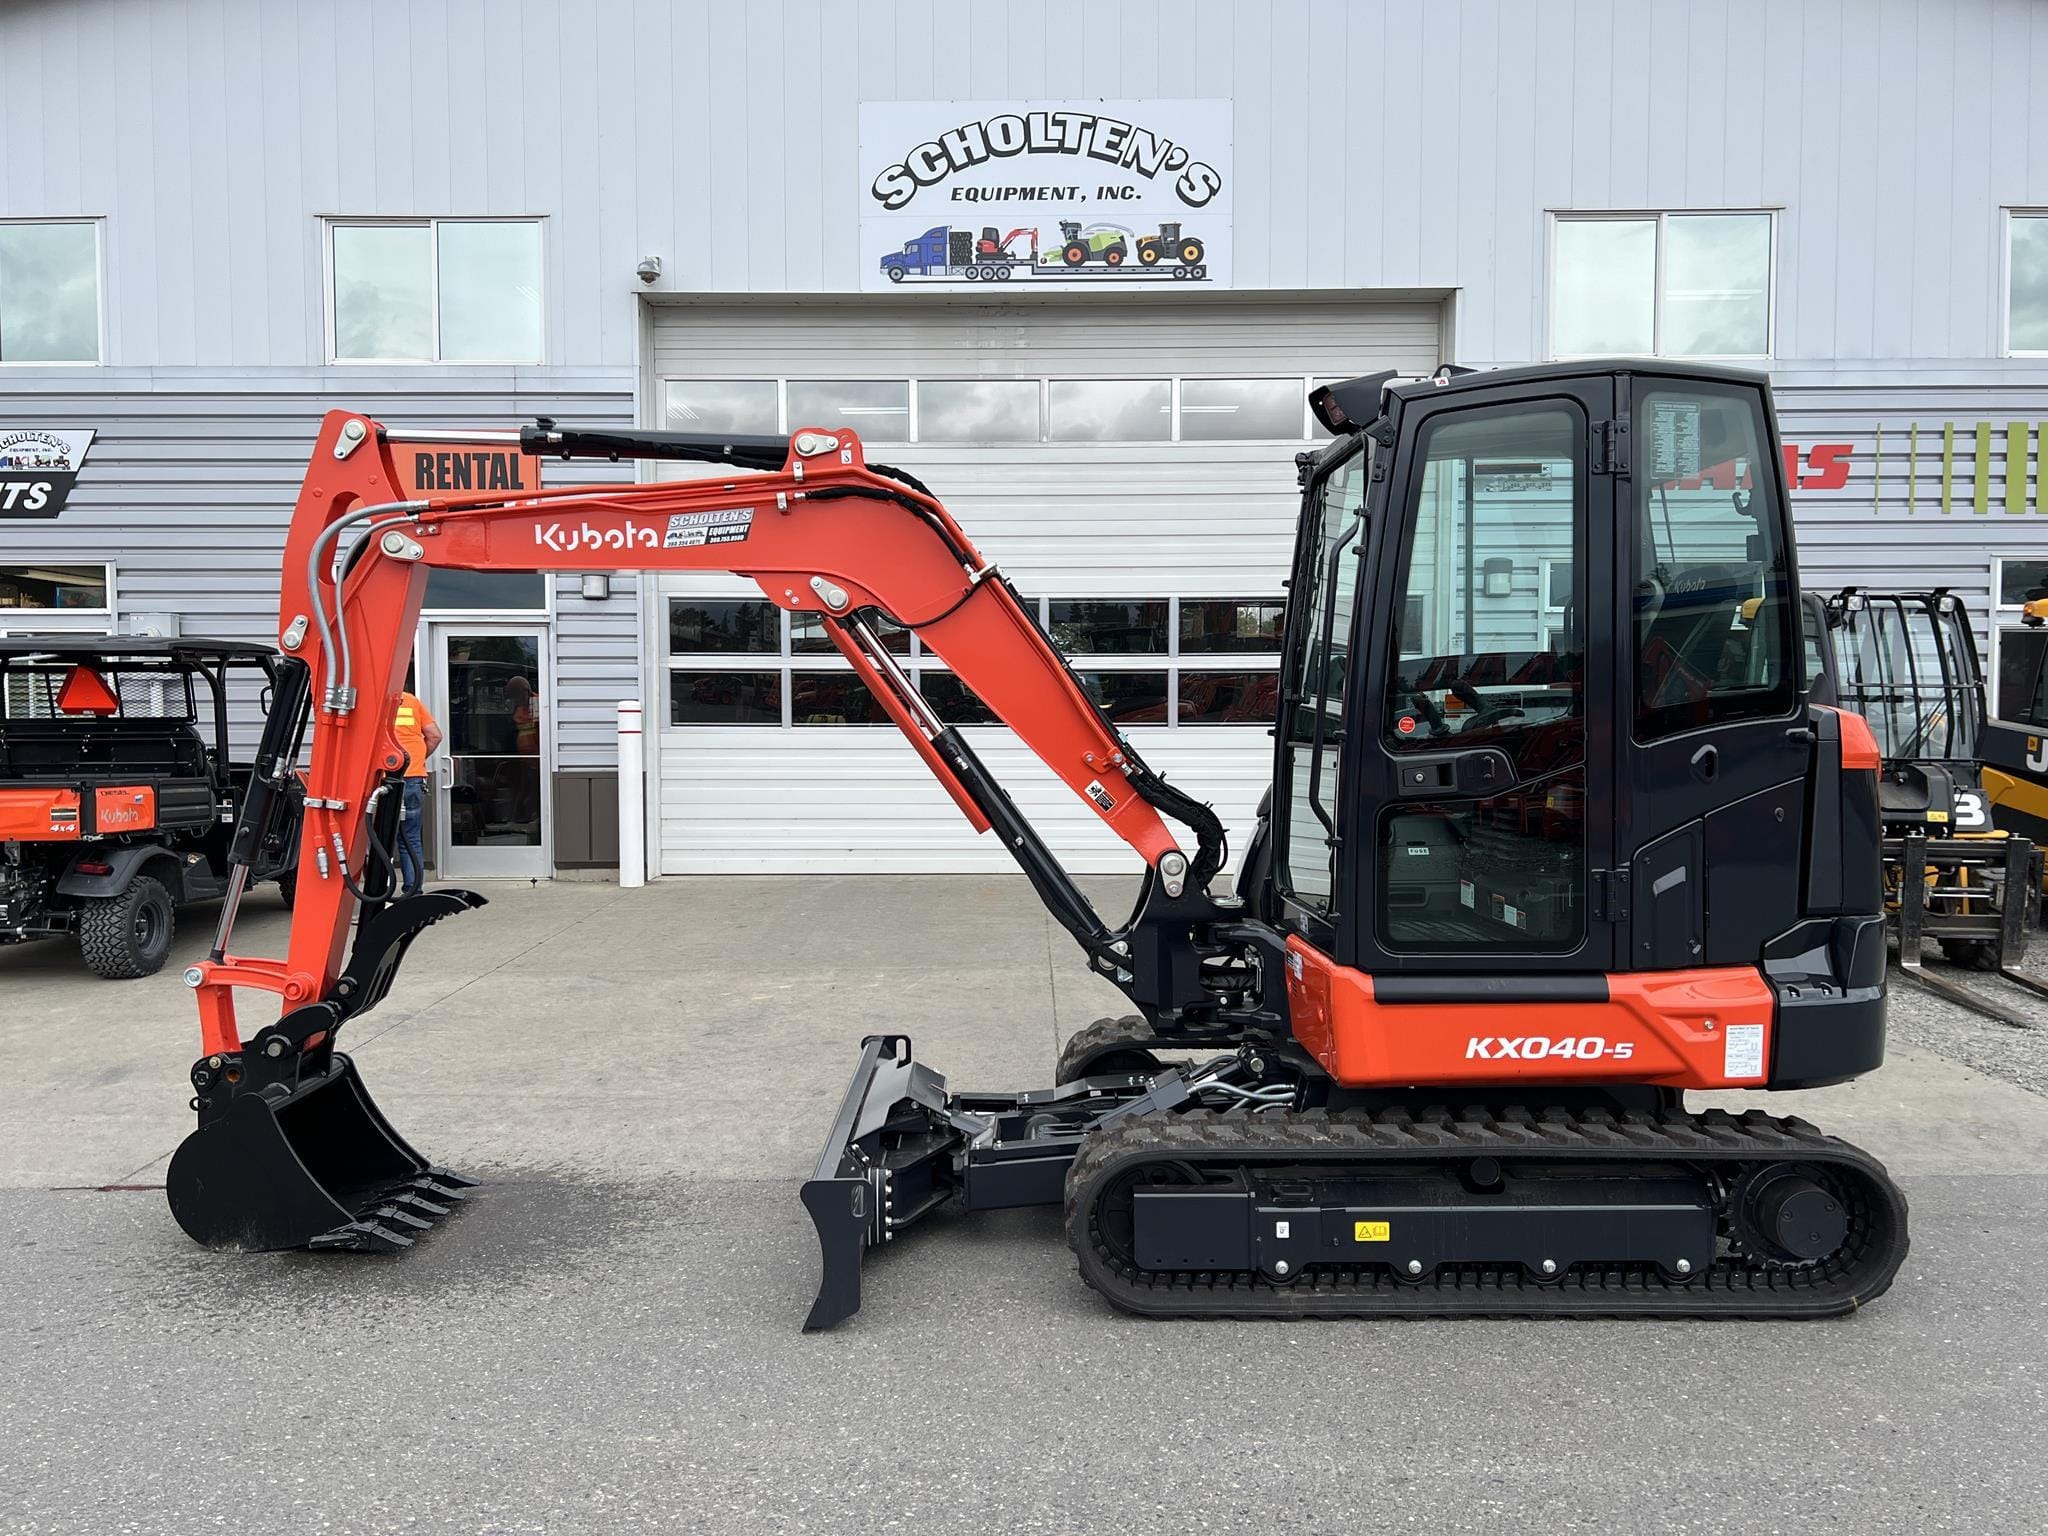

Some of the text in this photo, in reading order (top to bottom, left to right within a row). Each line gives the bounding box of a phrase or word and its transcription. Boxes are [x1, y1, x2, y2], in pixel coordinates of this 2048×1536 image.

[871, 111, 1222, 210] SCHOLTEN'S
[950, 185, 1142, 203] EQUIPMENT, INC.
[0, 431, 71, 454] CHOLTEN'S
[415, 452, 524, 490] RENTAL
[0, 482, 52, 510] TS
[670, 509, 752, 527] SCHOLTEN'S
[535, 520, 658, 552] Kubota
[708, 524, 750, 536] EQUIPMENT
[50, 824, 76, 832] 4x4
[1465, 1037, 1634, 1059] KX040-5
